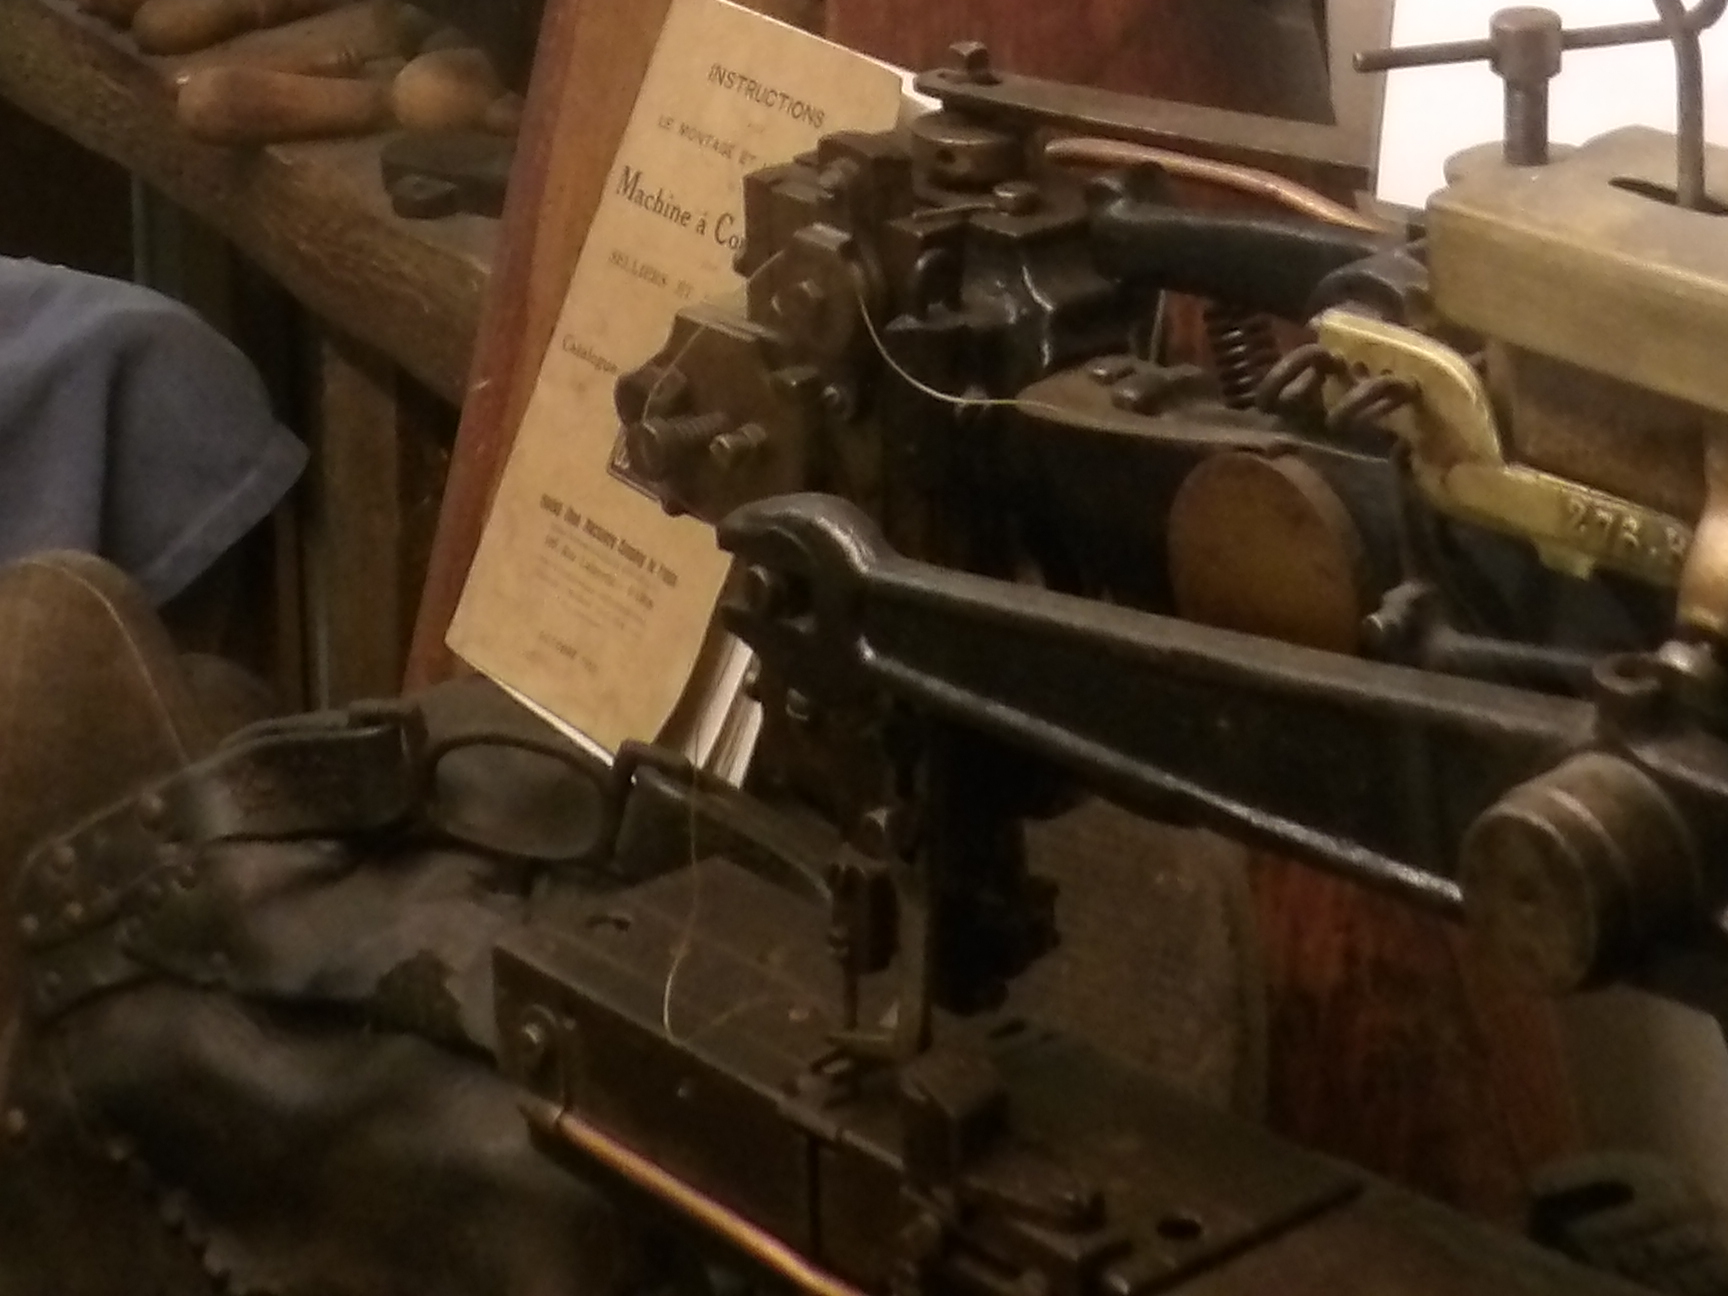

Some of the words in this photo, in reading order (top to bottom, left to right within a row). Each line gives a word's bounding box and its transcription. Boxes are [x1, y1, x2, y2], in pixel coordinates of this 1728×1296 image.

[707, 62, 827, 130] INSTRUCTIONS
[614, 165, 692, 230] Machine
[695, 209, 709, 233] à
